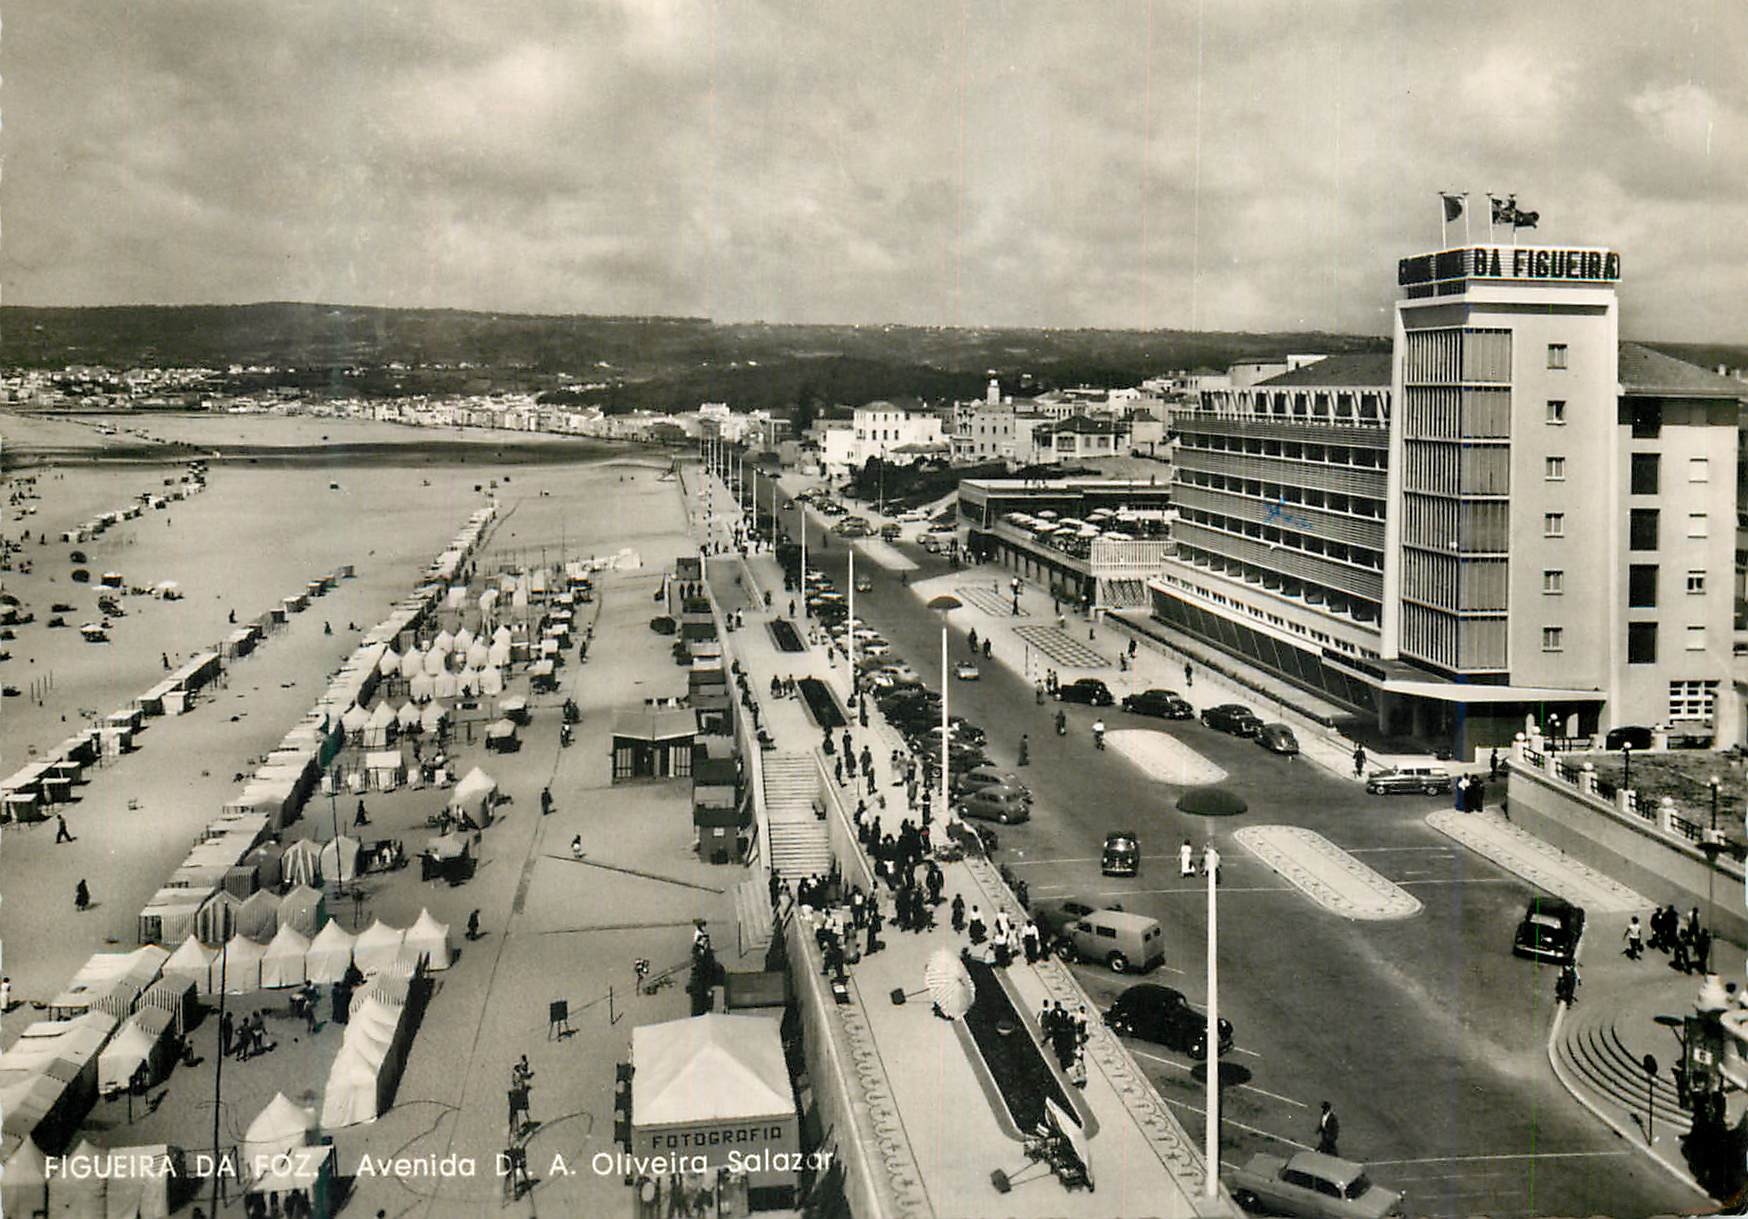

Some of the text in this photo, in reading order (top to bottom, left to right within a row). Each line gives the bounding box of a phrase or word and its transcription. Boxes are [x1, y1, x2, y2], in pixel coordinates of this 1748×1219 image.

[1474, 248, 1501, 277] DA
[1513, 249, 1620, 280] FIGUEIRA
[653, 1127, 781, 1148] FOTOGRAFIA
